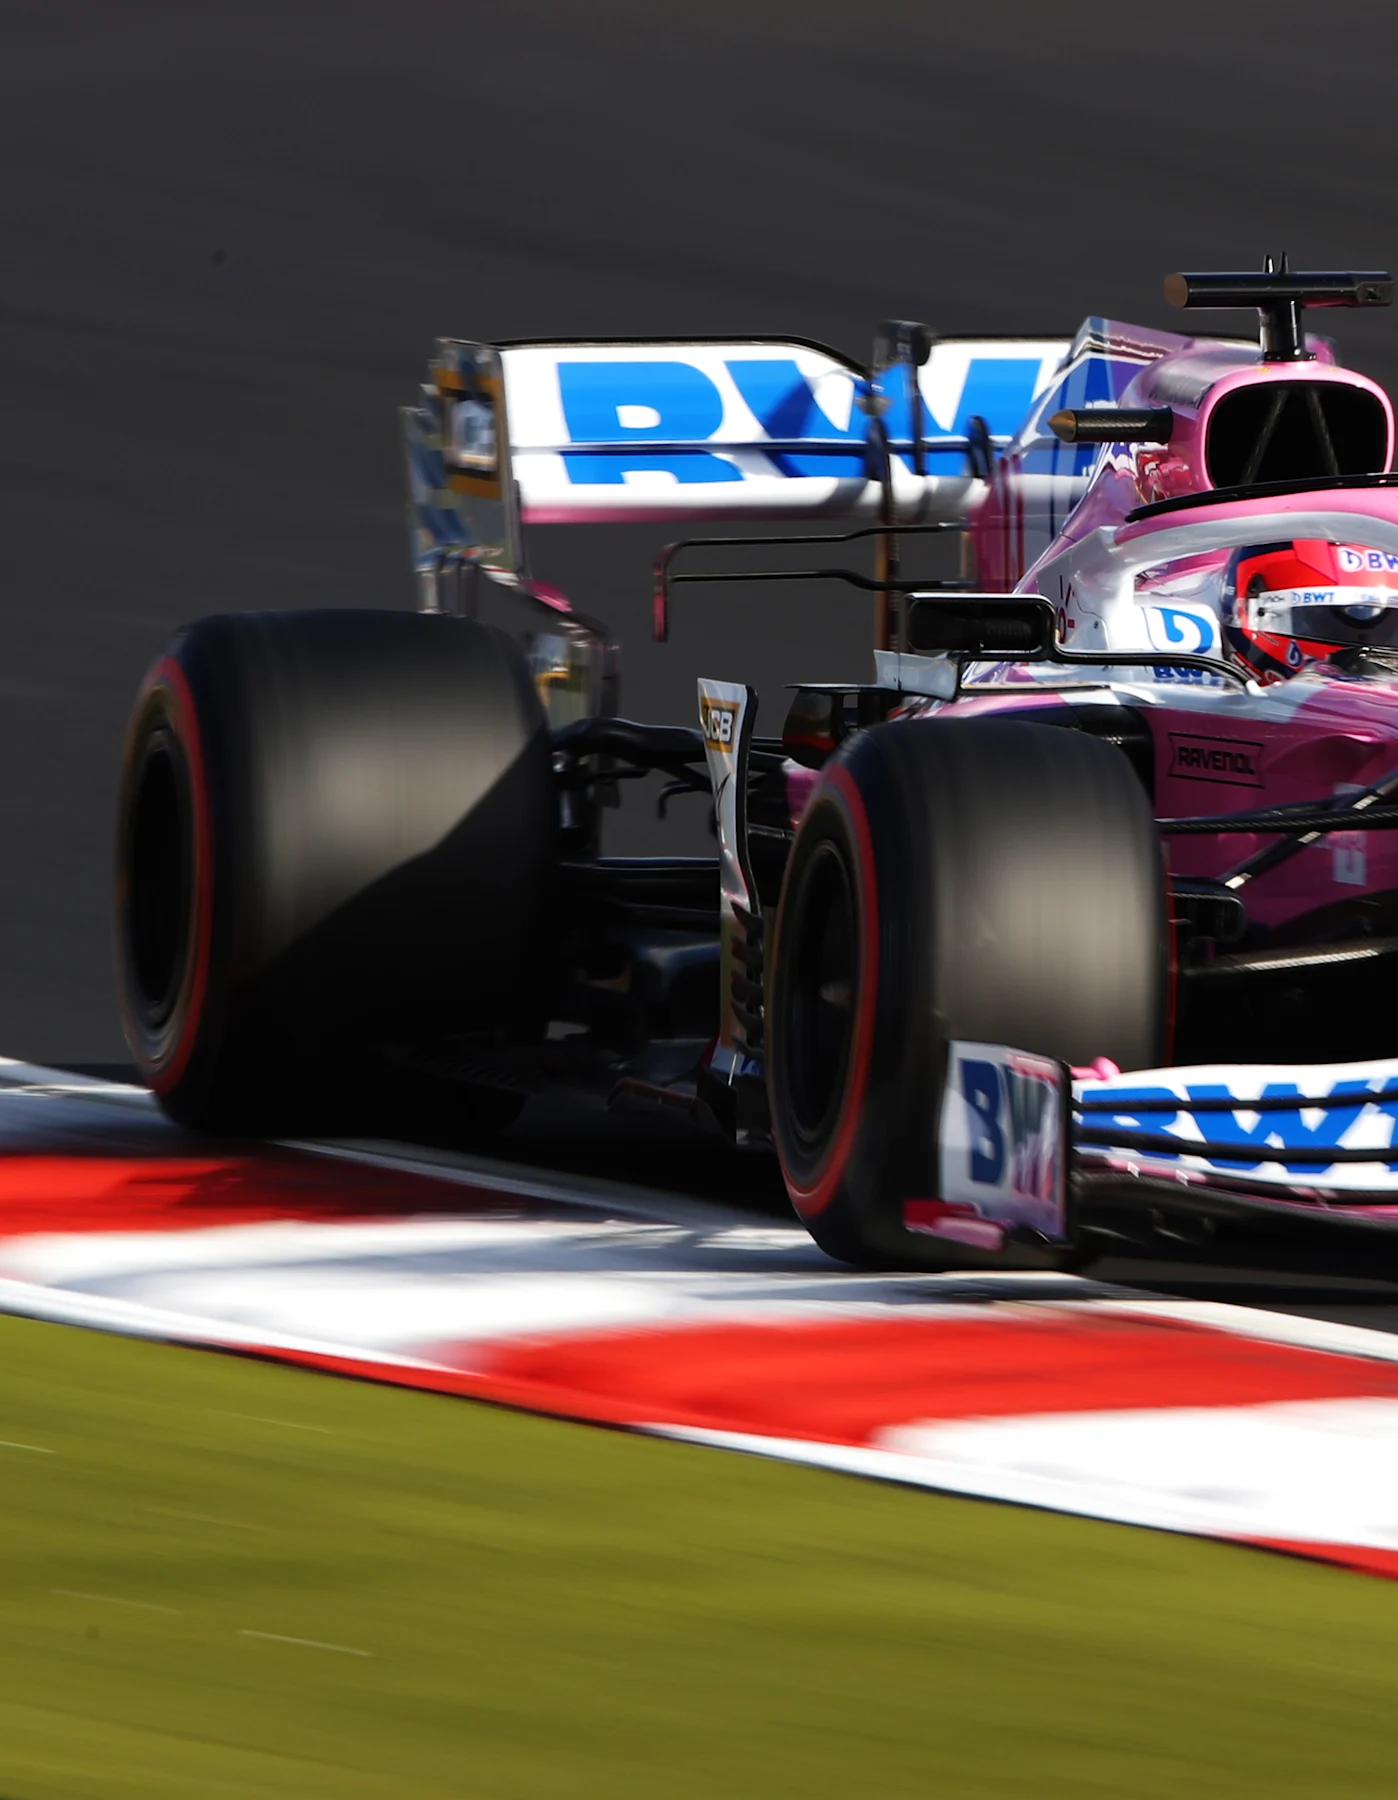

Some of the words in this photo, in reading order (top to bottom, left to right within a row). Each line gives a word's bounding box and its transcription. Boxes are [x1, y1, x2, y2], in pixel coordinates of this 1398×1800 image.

[1303, 592, 1335, 603] BWT
[704, 706, 735, 743] JCB
[1178, 746, 1255, 775] RAVENOL
